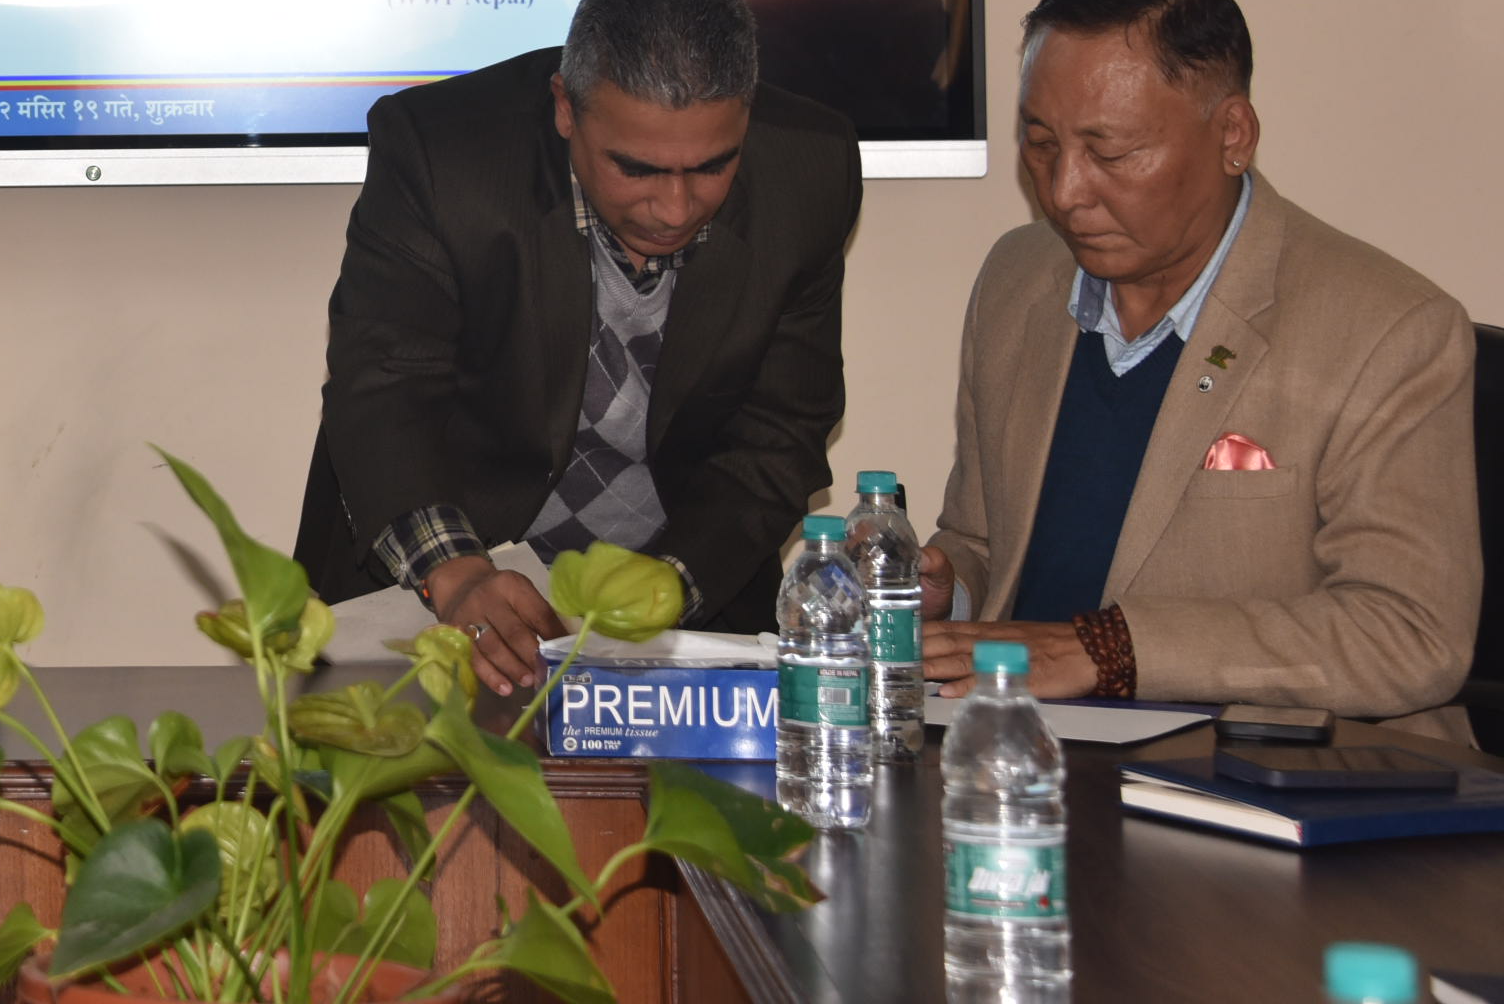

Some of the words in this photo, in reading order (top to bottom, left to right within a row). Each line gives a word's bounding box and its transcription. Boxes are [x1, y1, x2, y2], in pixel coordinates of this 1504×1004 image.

[17, 95, 66, 119] मंसिर
[74, 100, 98, 120] १९
[104, 94, 142, 121] गते,
[562, 684, 779, 727] PREMIUM
[563, 725, 580, 736] the
[584, 727, 623, 736] PREMIUM
[624, 726, 659, 738] tissue
[581, 739, 603, 750] 100
